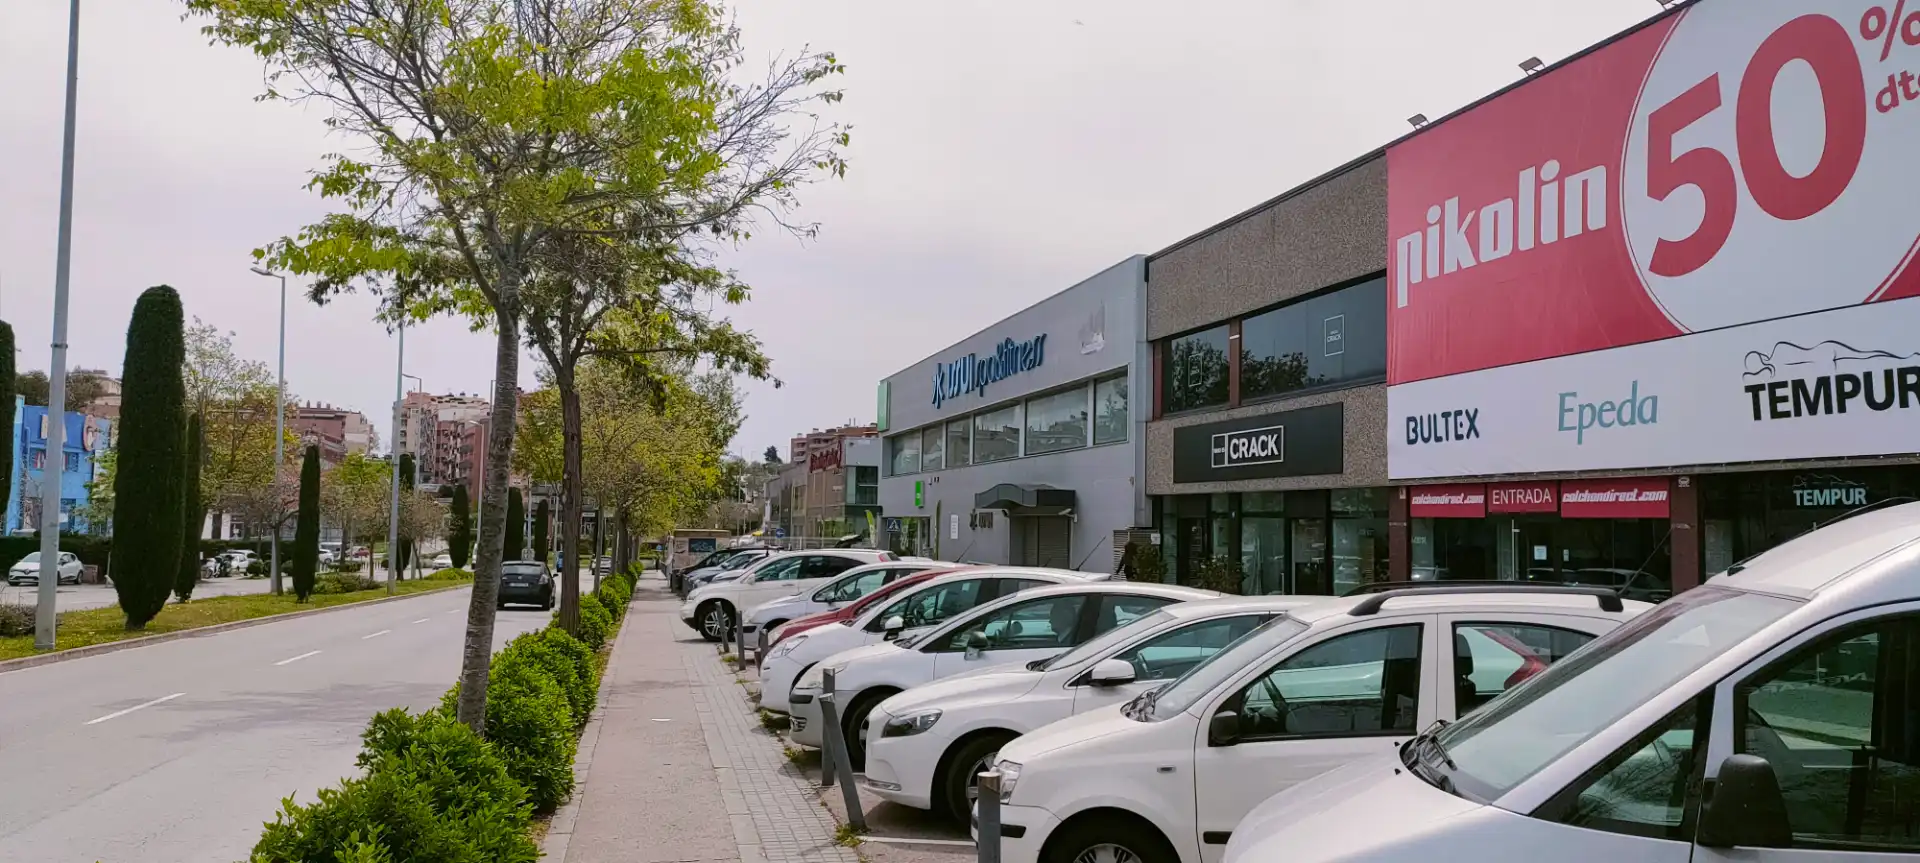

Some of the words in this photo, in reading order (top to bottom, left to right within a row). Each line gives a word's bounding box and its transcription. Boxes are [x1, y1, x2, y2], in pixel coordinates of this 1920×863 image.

[1876, 70, 1920, 113] dt
[1647, 13, 1867, 278] 50
[1396, 159, 1607, 309] pikolin
[1557, 380, 1659, 445] Epeda
[1744, 365, 1920, 421] TEMPUR
[1229, 433, 1279, 460] CRACK
[1406, 408, 1480, 445] BULTEX
[1492, 487, 1552, 506] ENTRADA
[1562, 488, 1668, 503] colchondirect.com
[1793, 487, 1867, 506] TEMPUR
